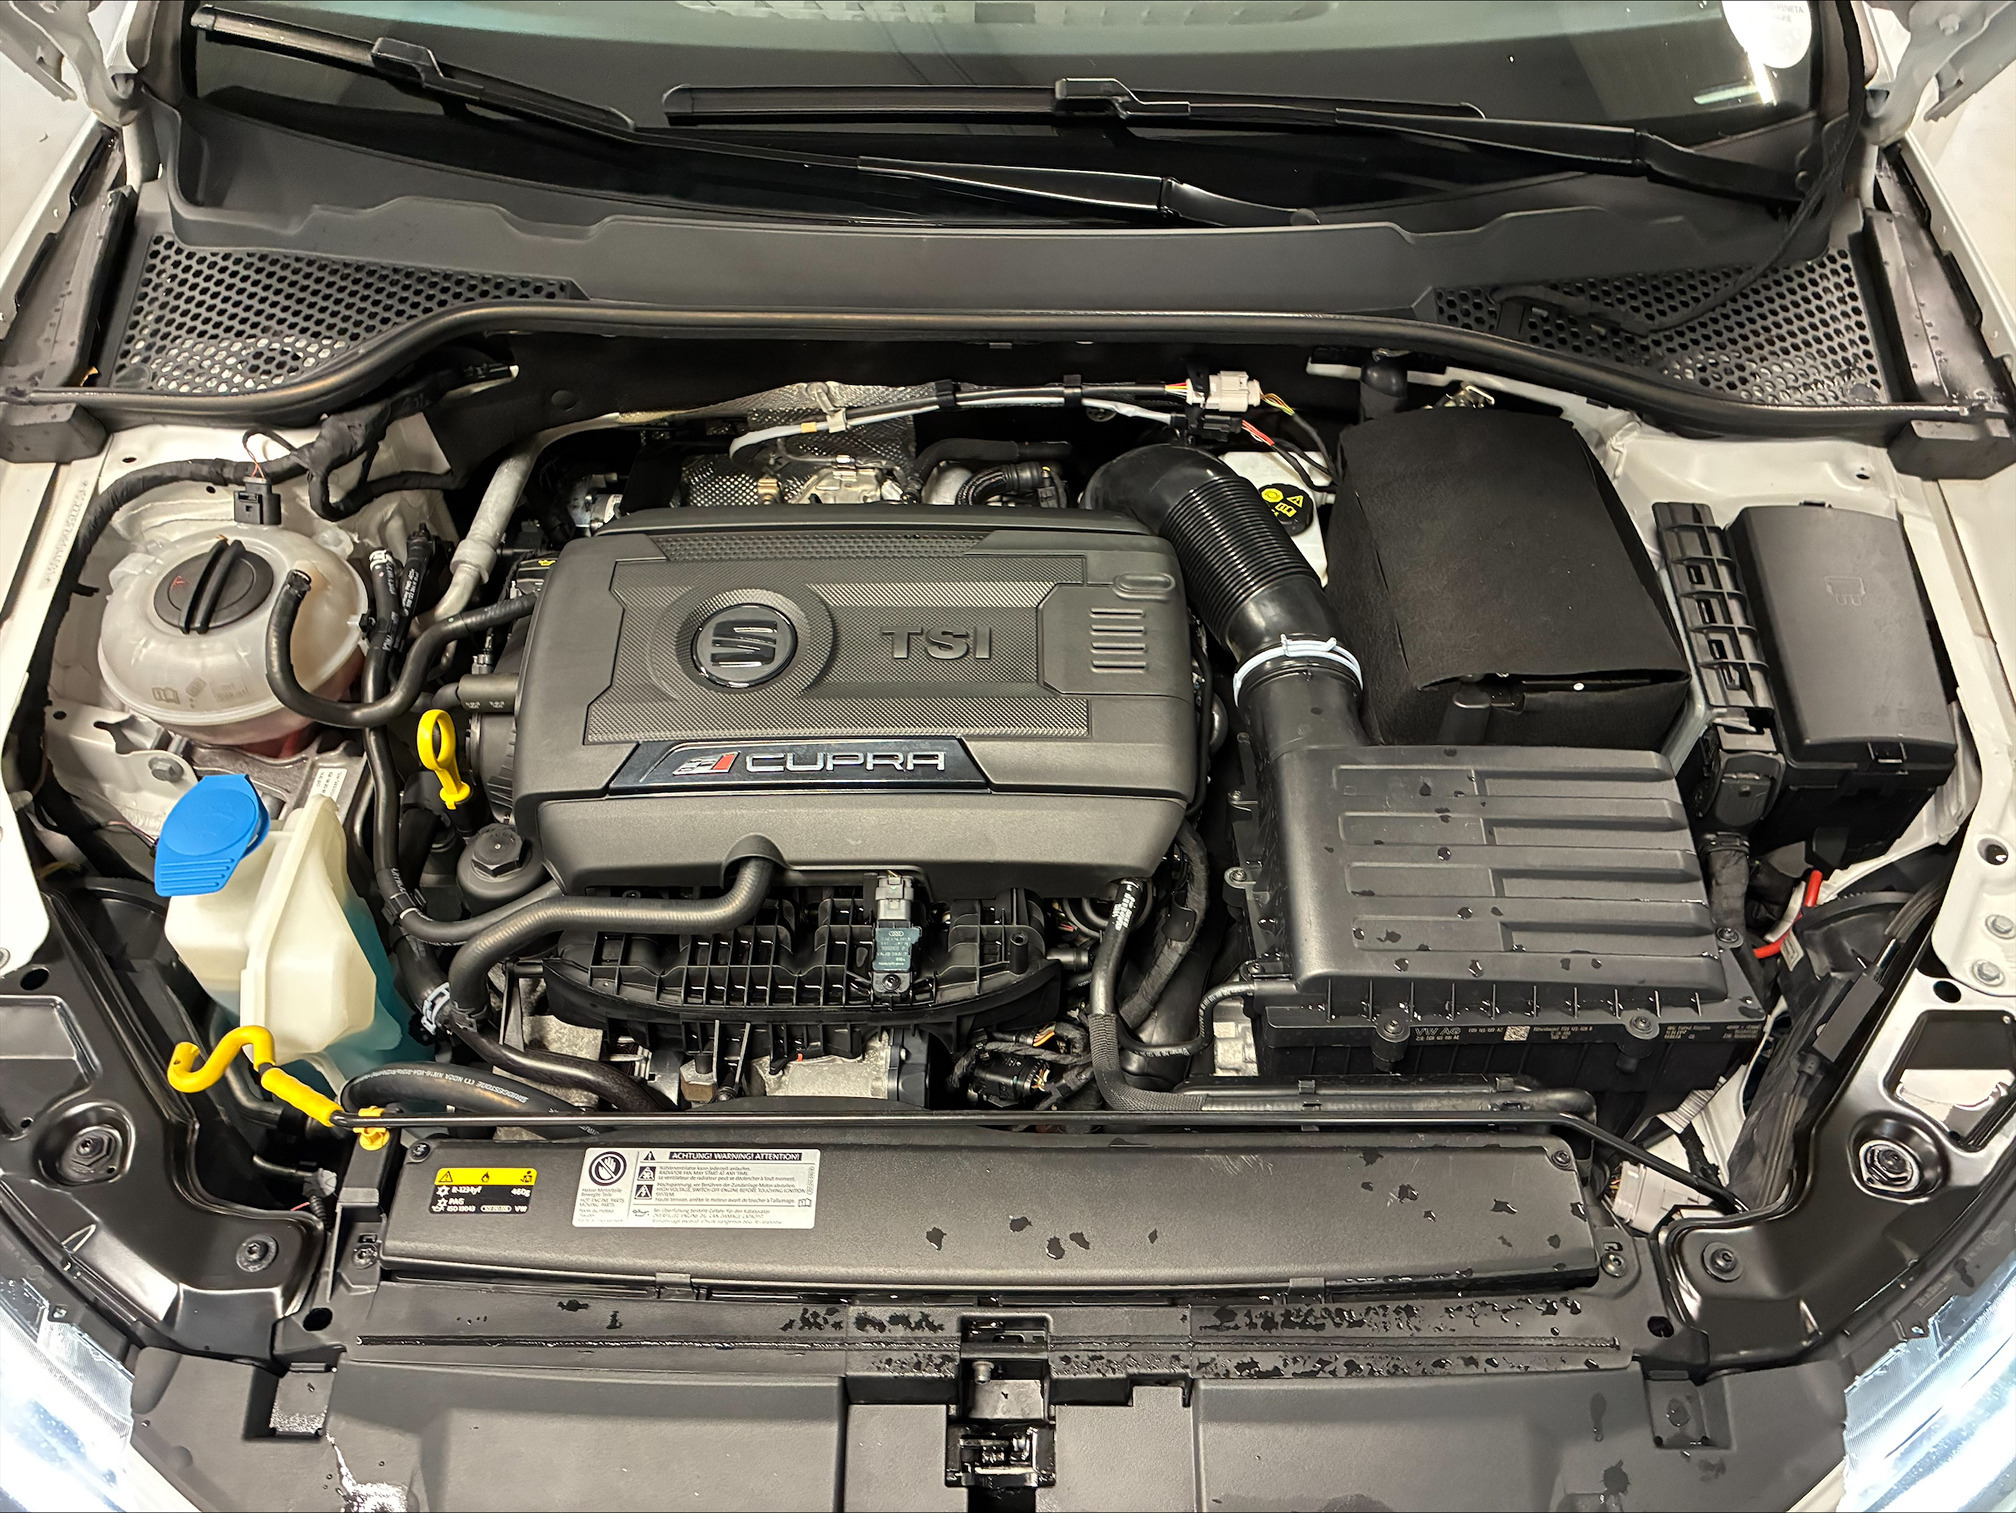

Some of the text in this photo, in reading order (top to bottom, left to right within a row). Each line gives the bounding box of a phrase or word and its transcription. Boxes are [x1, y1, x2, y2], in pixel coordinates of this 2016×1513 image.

[882, 625, 994, 660] TSI
[744, 750, 946, 772] CUPRA
[1414, 1027, 1439, 1036] VW
[476, 1080, 529, 1103] BRIDGESTONE
[672, 1152, 713, 1160] ACHTUNG!
[713, 1152, 754, 1160] WARNING!
[451, 1186, 482, 1195] R-1234yf
